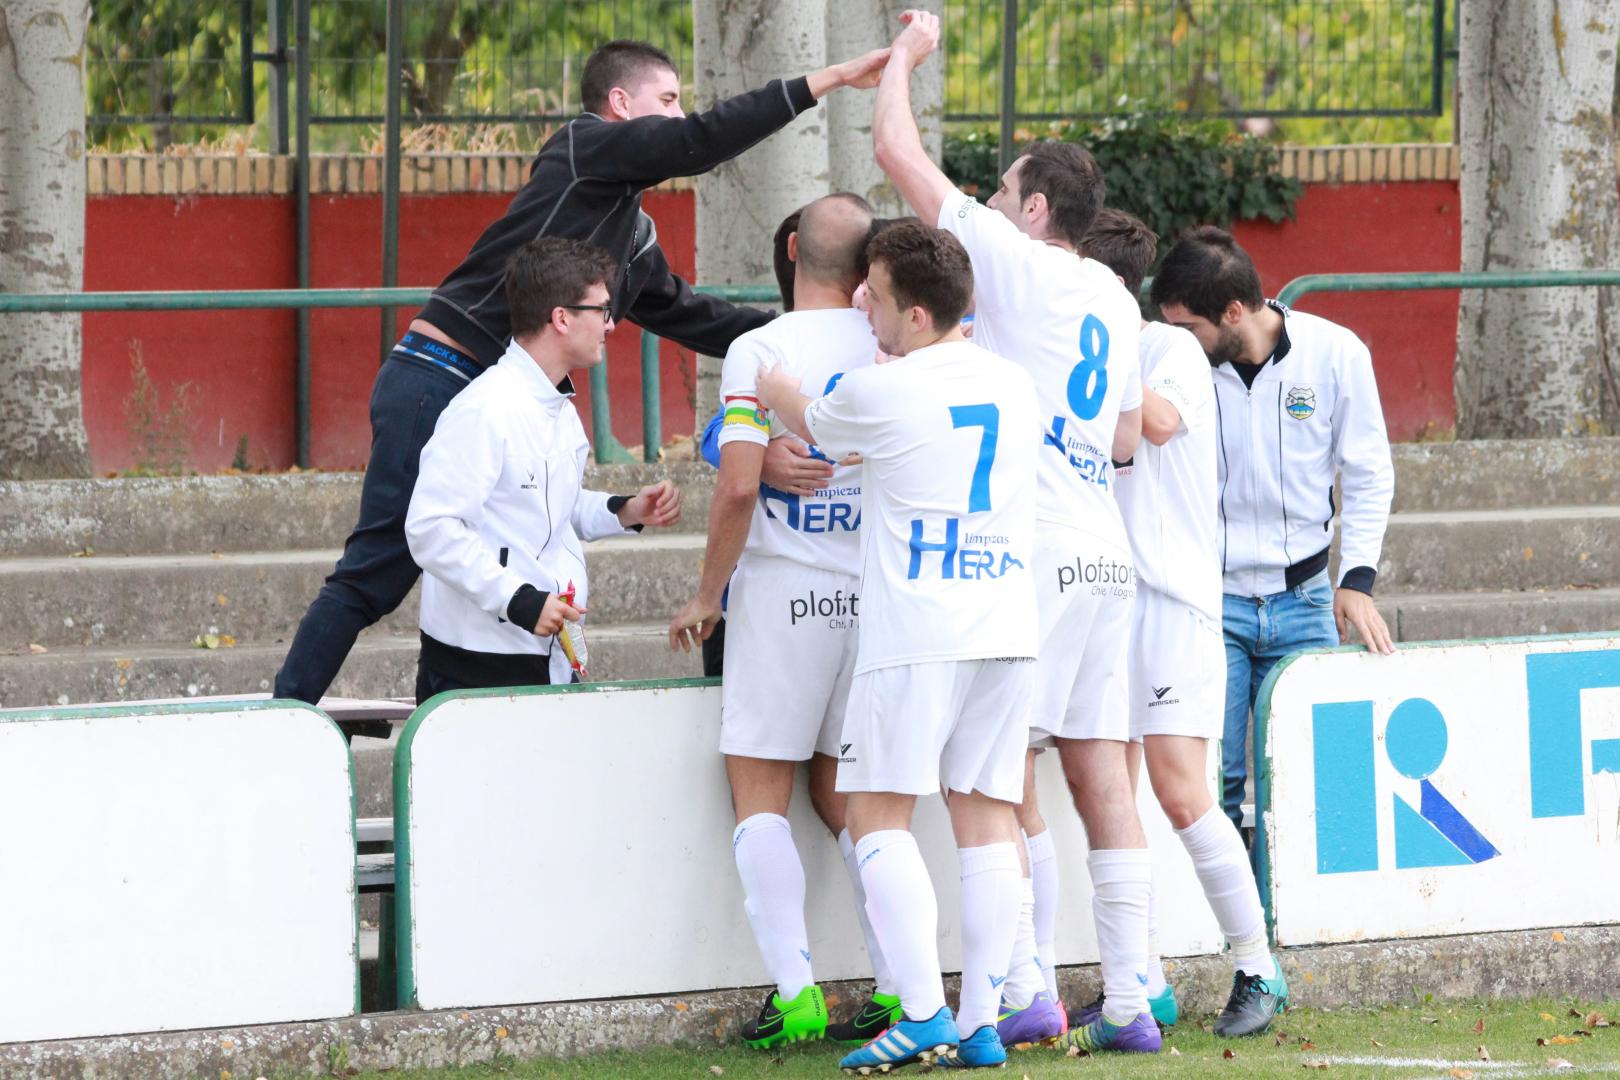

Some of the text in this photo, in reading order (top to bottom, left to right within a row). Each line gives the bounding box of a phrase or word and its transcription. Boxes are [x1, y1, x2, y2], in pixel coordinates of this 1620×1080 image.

[422, 342, 449, 359] JACK
[1067, 313, 1109, 421] 8
[948, 403, 999, 514] 7
[908, 518, 1024, 580] HERA
